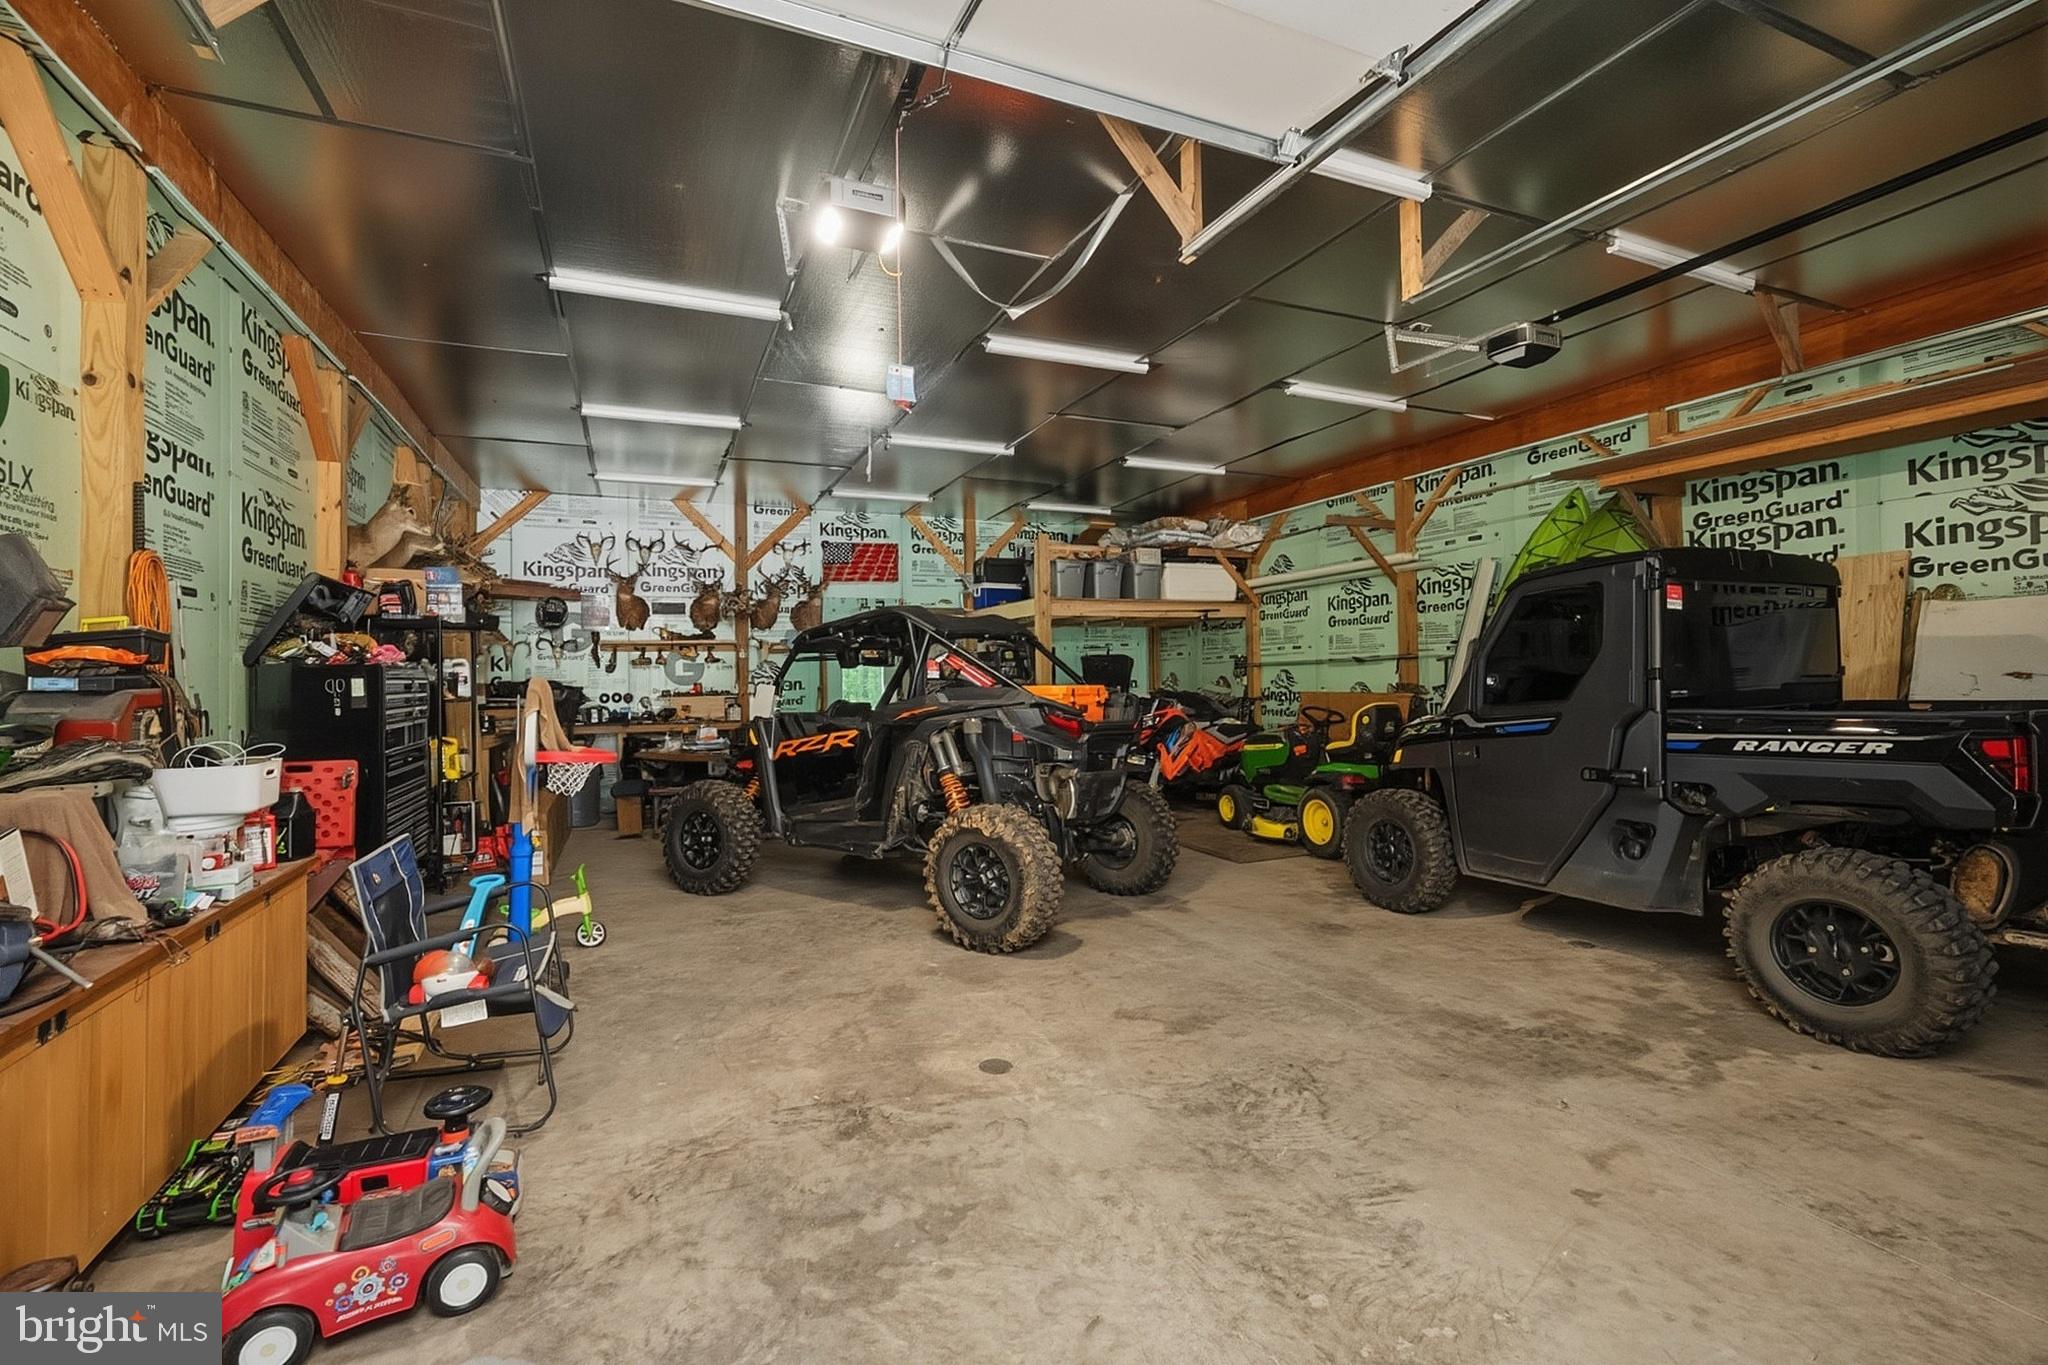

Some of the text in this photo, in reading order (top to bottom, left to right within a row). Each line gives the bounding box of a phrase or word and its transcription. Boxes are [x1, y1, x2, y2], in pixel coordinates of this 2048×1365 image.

[1692, 489, 1842, 530] GreenGuard
[773, 729, 859, 762] RZR
[1732, 740, 1895, 755] RANGER
